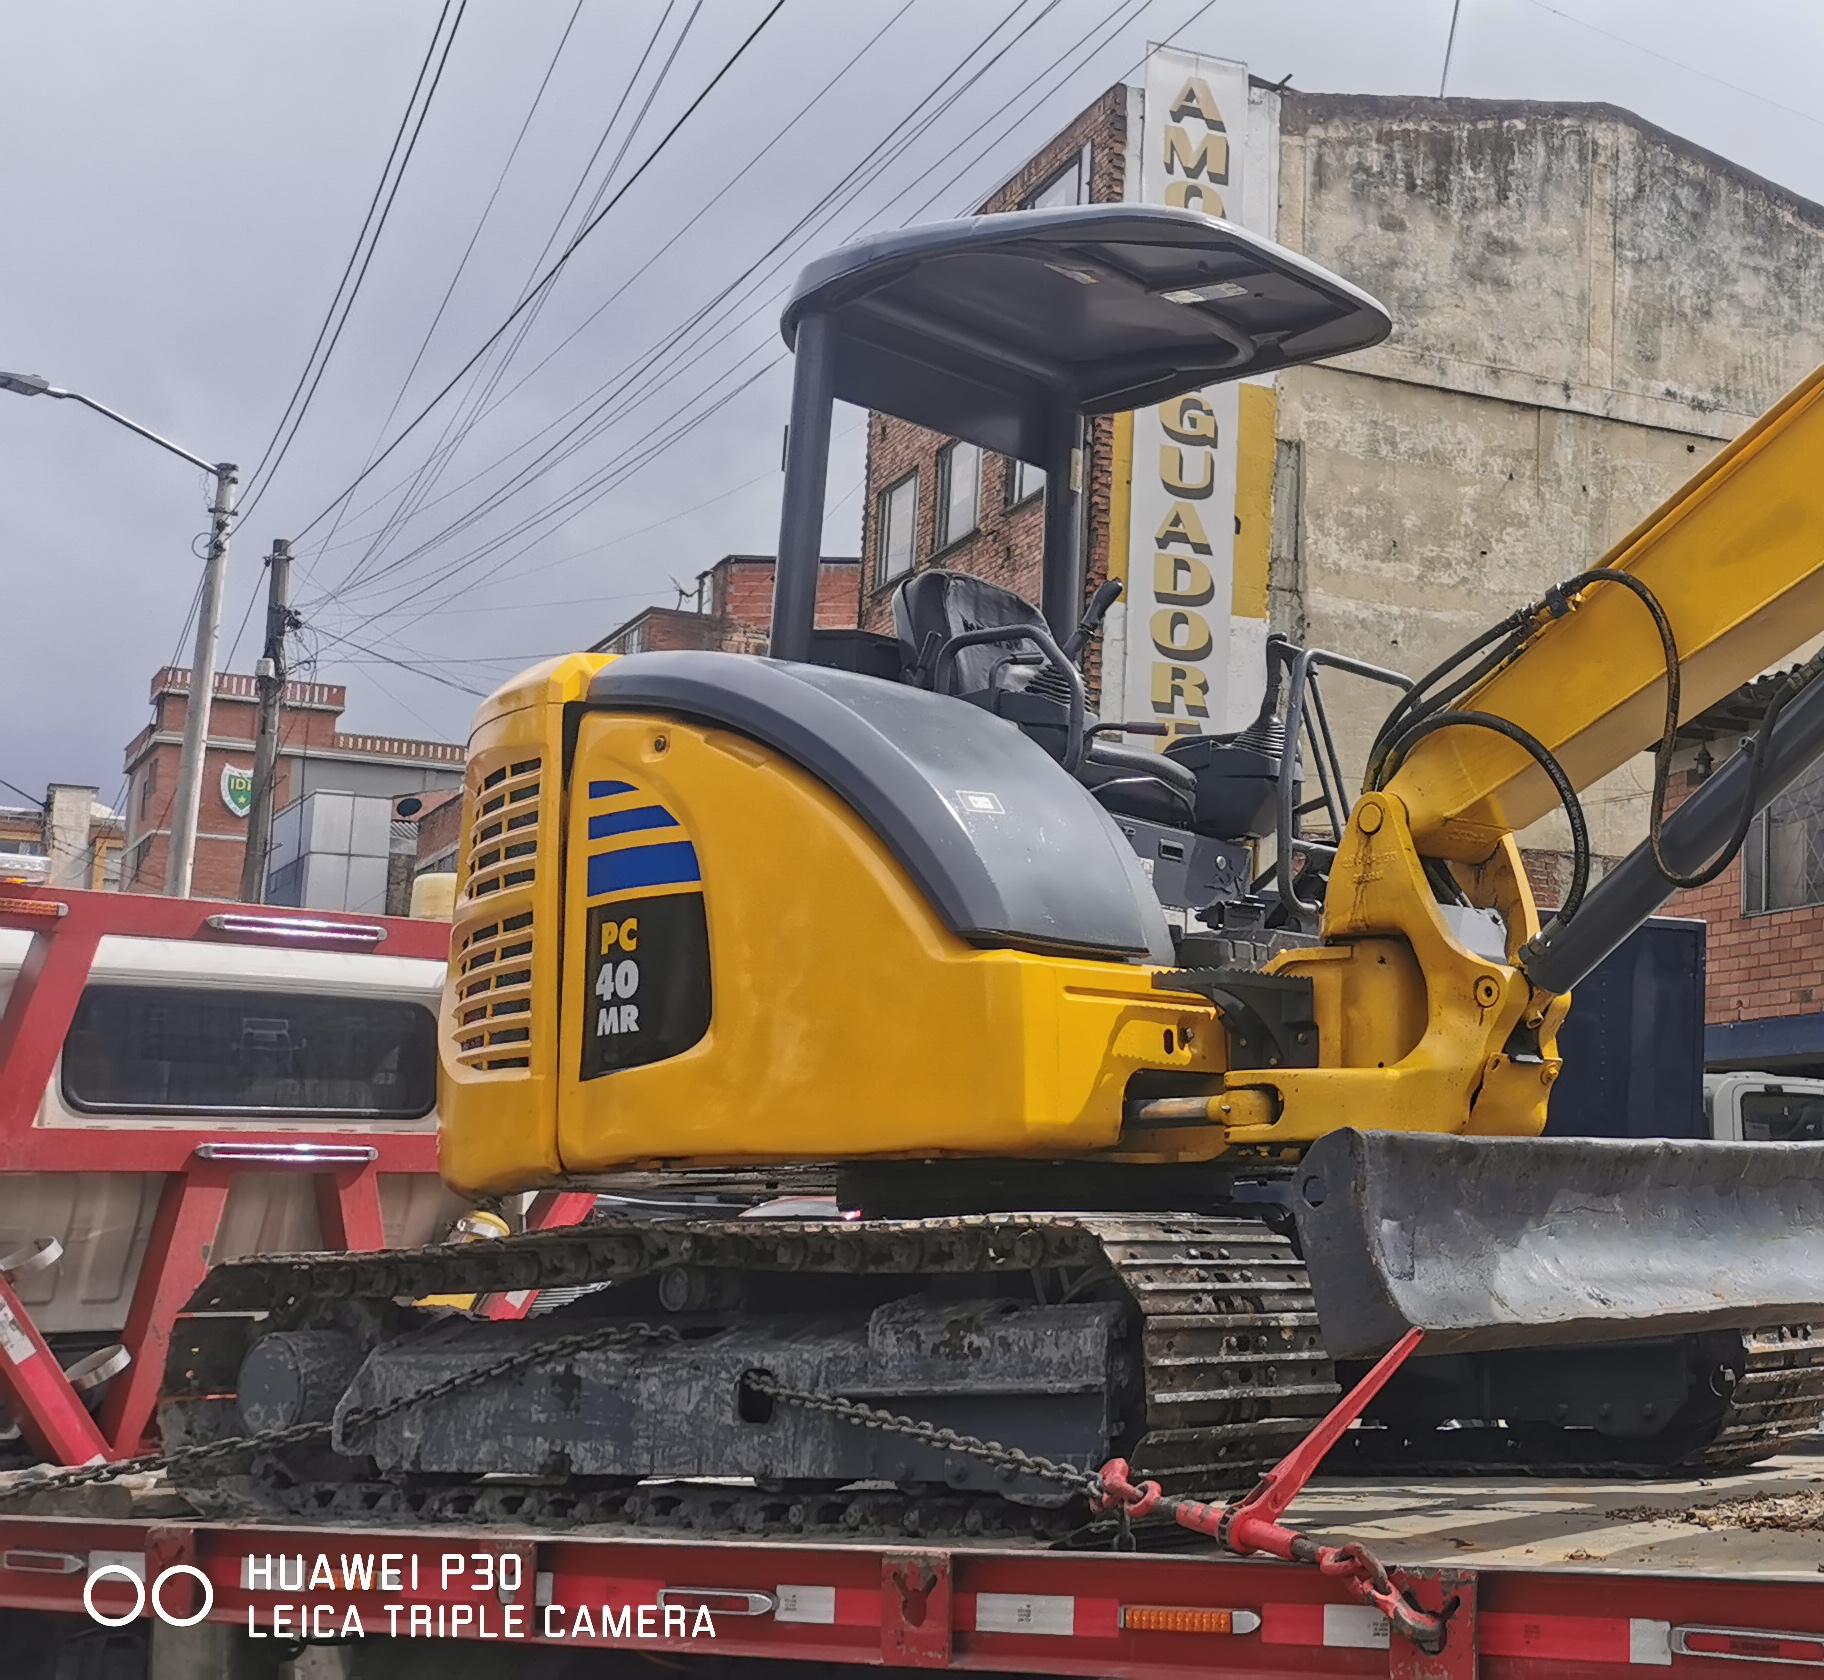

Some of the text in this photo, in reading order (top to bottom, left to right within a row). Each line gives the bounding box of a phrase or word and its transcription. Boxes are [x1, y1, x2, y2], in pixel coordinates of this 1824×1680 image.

[601, 918, 638, 955] PC
[595, 959, 639, 1001] 40
[596, 1004, 640, 1037] MR
